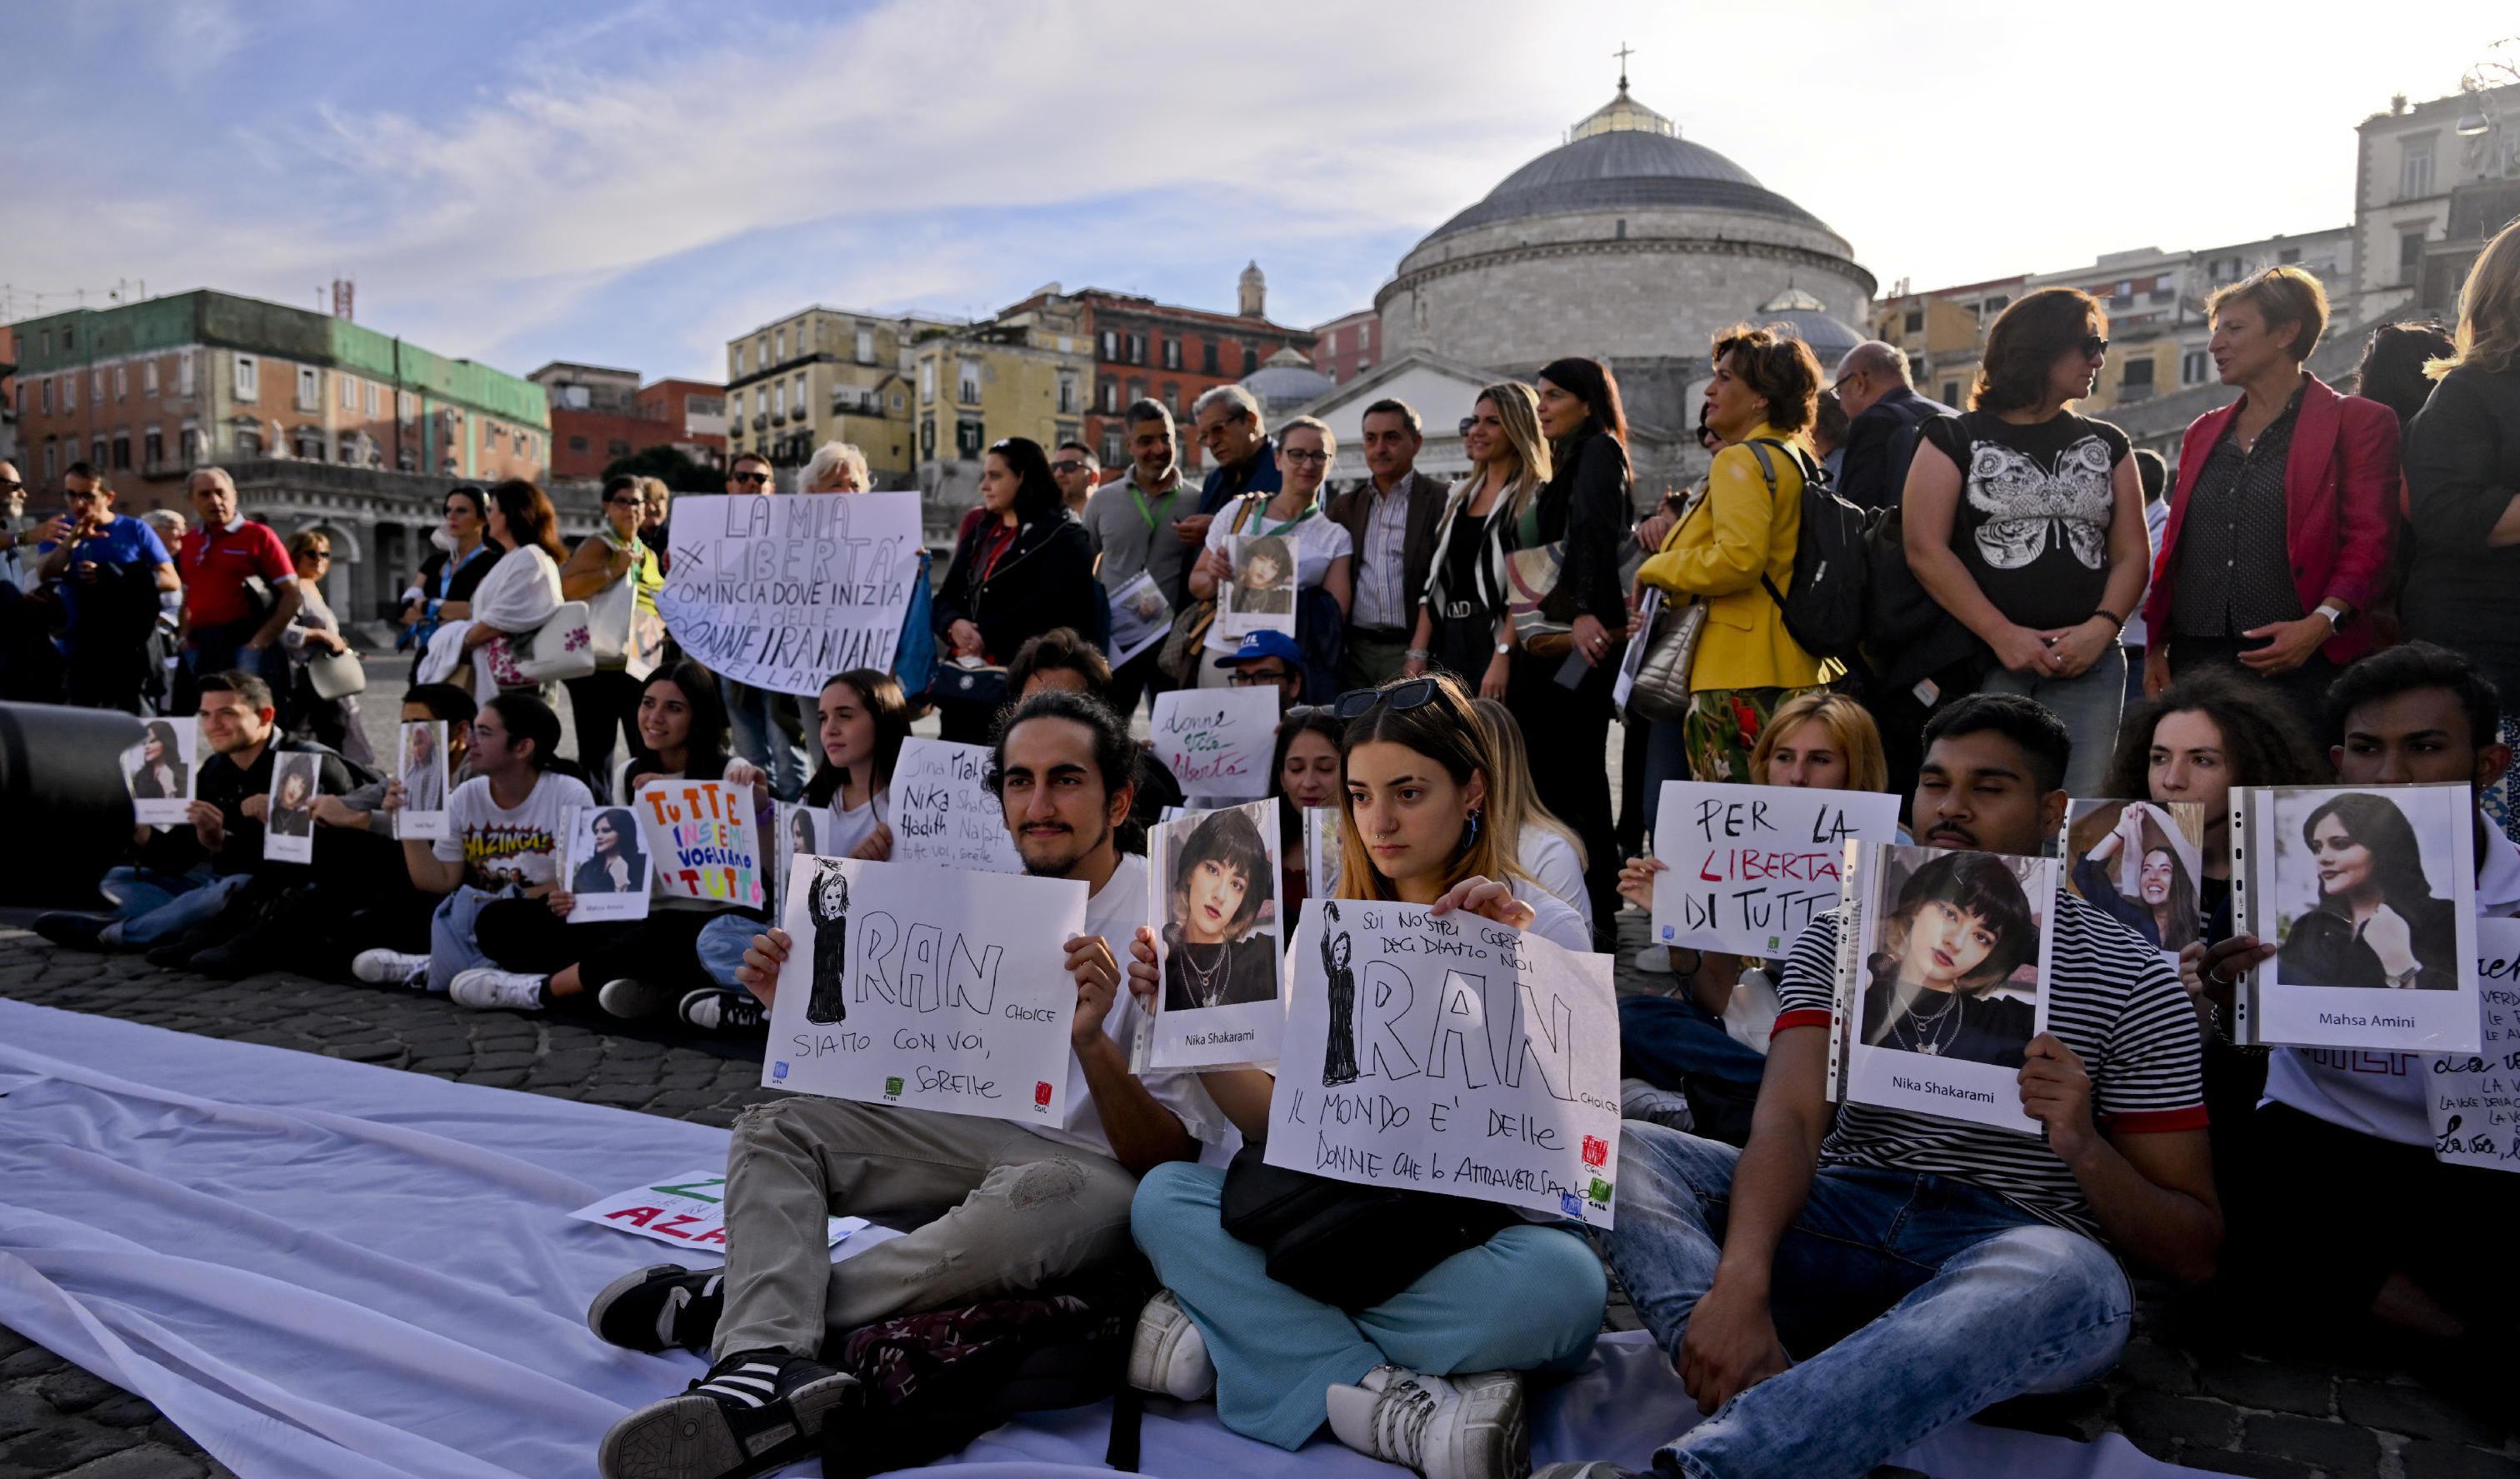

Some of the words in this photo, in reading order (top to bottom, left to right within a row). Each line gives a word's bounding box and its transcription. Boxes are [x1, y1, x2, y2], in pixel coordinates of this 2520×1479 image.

[726, 496, 769, 537] LA
[787, 497, 849, 538] MIA
[662, 582, 768, 605] COMINCIA
[773, 582, 821, 605] DOVE
[832, 582, 903, 605] INIZIA
[757, 626, 897, 669] IRANIANE
[952, 750, 980, 783] Mah
[1695, 799, 1778, 842] PER
[1812, 803, 1860, 843] LA
[672, 822, 750, 850] INSIEME
[677, 847, 751, 868] VOGLIAMO
[1685, 892, 1717, 931] DI
[1732, 887, 1841, 931] TUTT
[1500, 953, 1533, 973] NOI
[1004, 1003, 1056, 1023] CHOICE
[2319, 1012, 2367, 1026] Mahsa
[2371, 1014, 2415, 1028] Amini
[793, 1032, 871, 1057] SIAMO
[893, 1028, 936, 1052] CON
[1185, 1034, 1206, 1047] Nika
[1208, 1029, 1255, 1045] Shakarami
[1892, 1076, 1921, 1092] Nika
[1925, 1082, 1994, 1104] Shakarami
[2482, 1077, 2503, 1093] LA
[1288, 1087, 1306, 1125] IL
[1319, 1092, 1410, 1133] MONDO
[1580, 1092, 1620, 1116] CHOICE
[1316, 1131, 1382, 1179] DONNE
[1392, 1152, 1422, 1179] CHE
[1453, 1156, 1592, 1201] ATTRAVERSANO
[1585, 1163, 1602, 1177] CGIL
